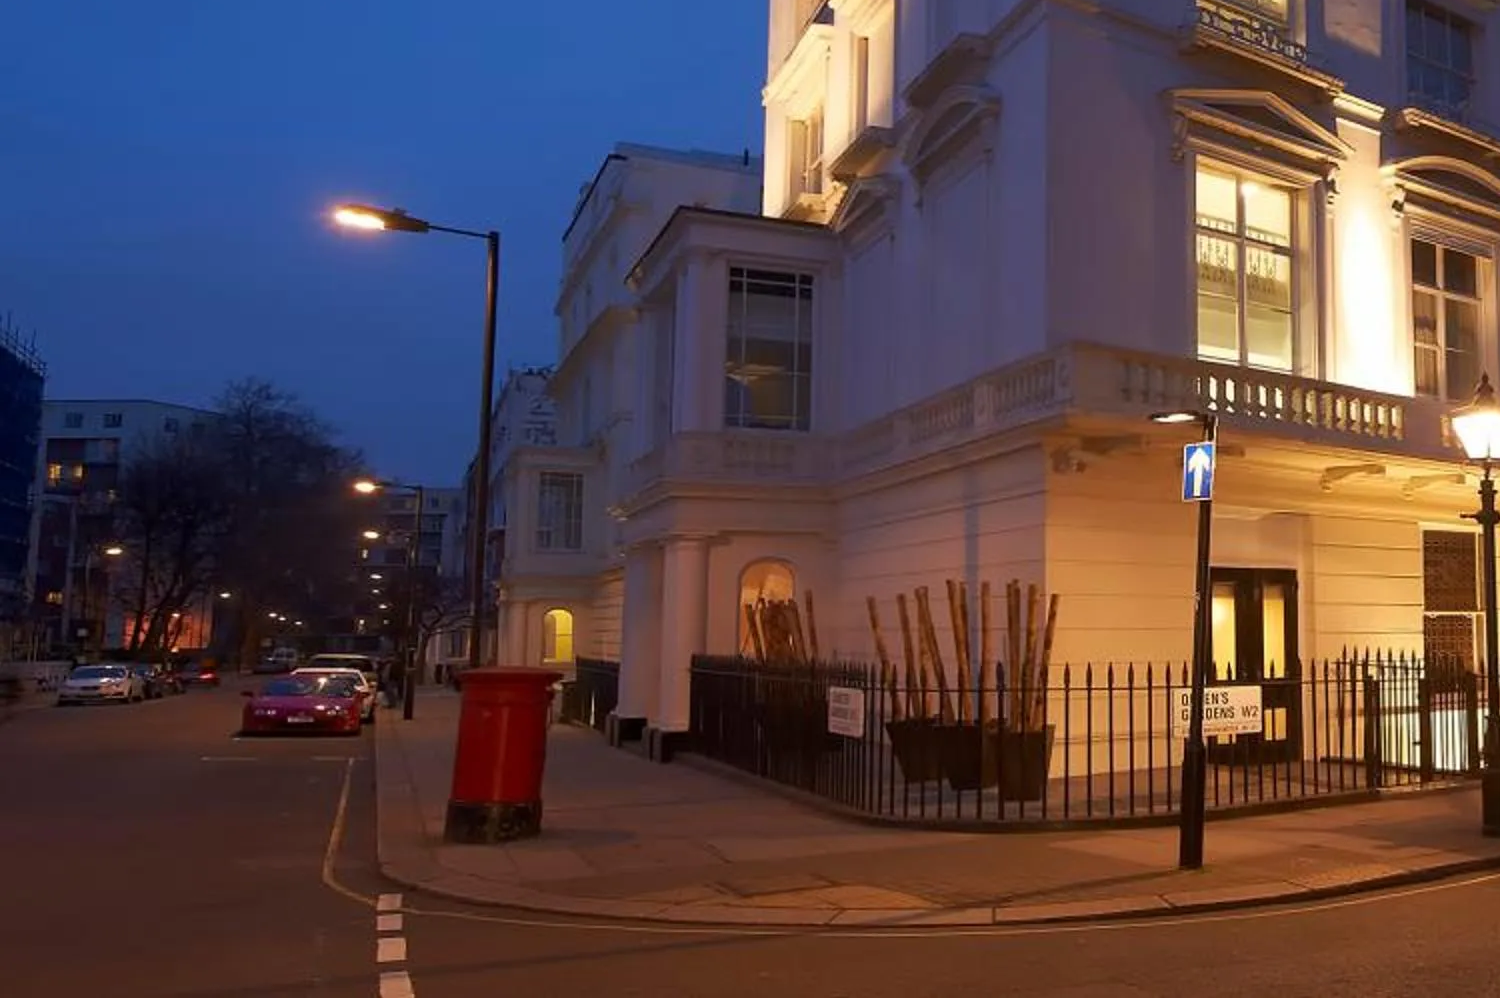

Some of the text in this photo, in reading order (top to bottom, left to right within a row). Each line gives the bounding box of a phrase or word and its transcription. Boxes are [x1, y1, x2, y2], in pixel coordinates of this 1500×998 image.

[1181, 692, 1229, 706] QEN'S
[1181, 705, 1259, 721] GDENS W2
